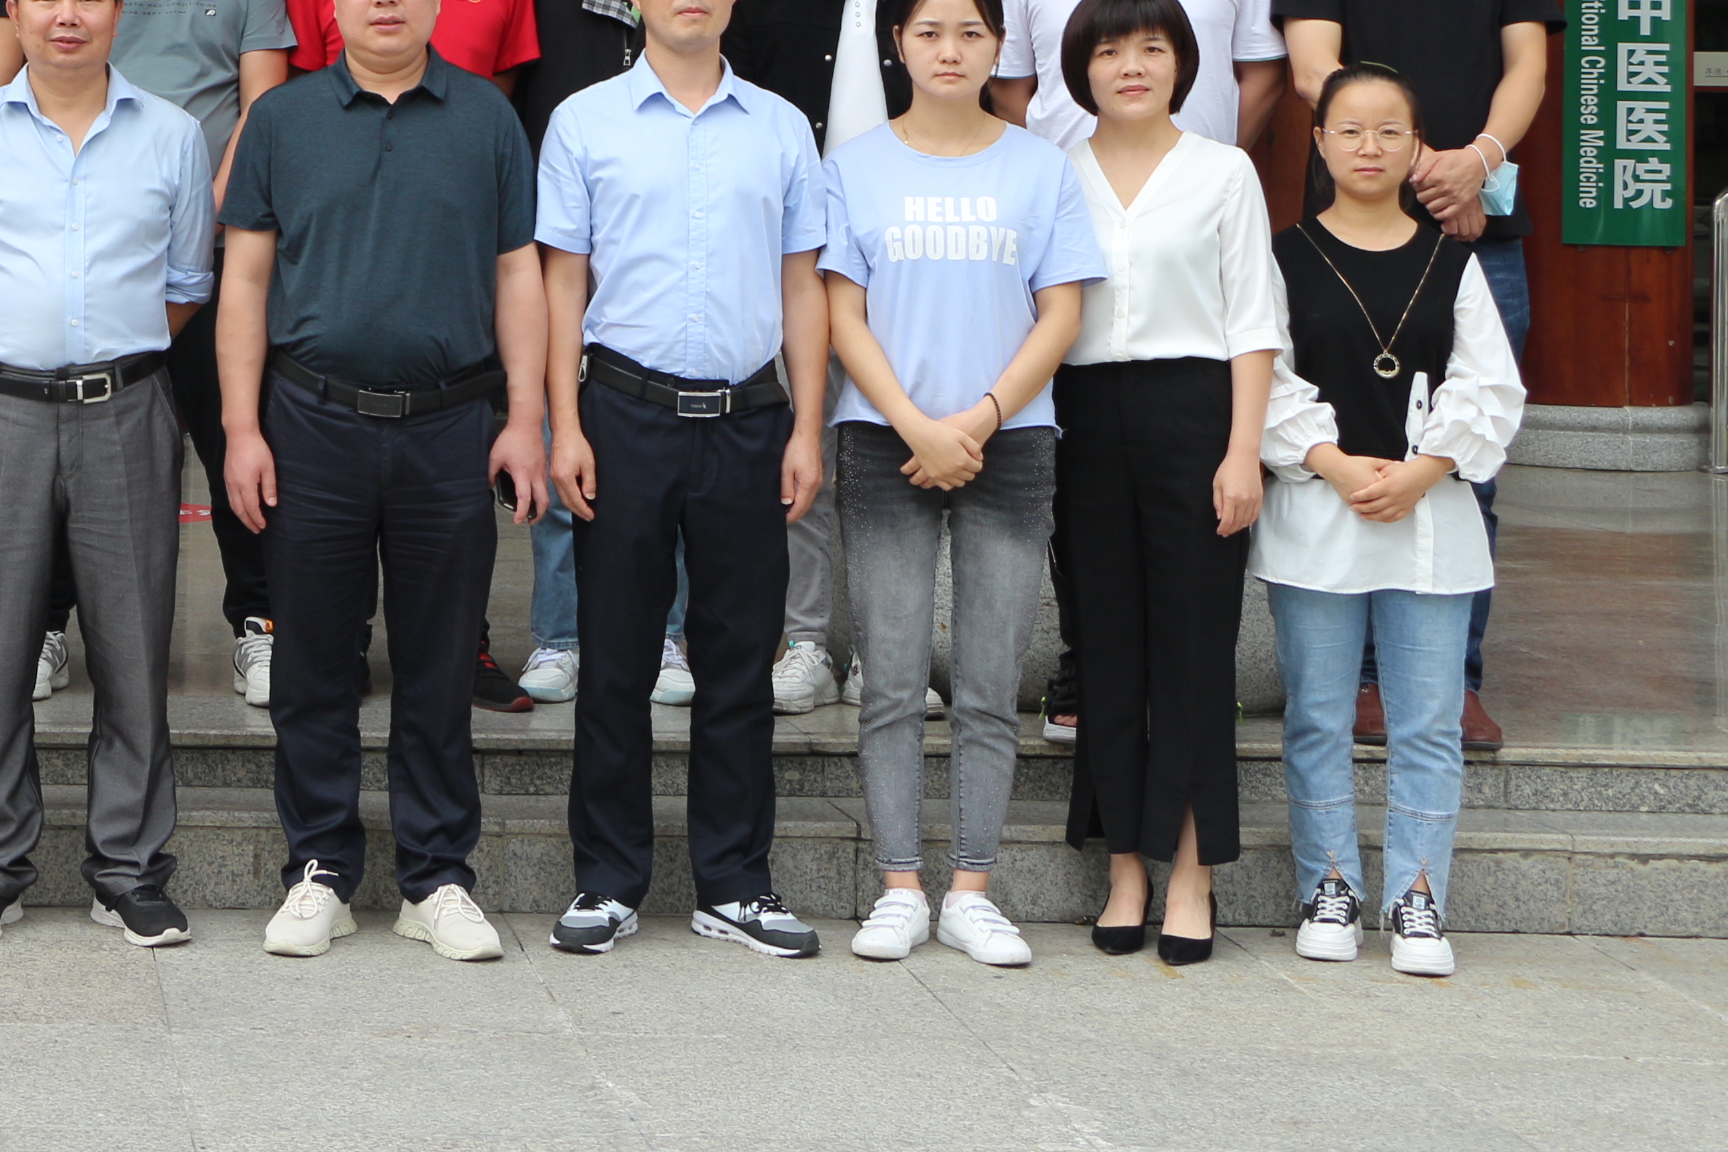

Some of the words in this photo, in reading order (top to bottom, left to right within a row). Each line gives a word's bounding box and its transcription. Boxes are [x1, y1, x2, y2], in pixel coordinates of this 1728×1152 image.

[1580, 55, 1605, 125] Chinese
[1579, 129, 1604, 209] Medicine
[904, 196, 998, 223] HELLO
[884, 224, 1018, 266] GOODBYE
